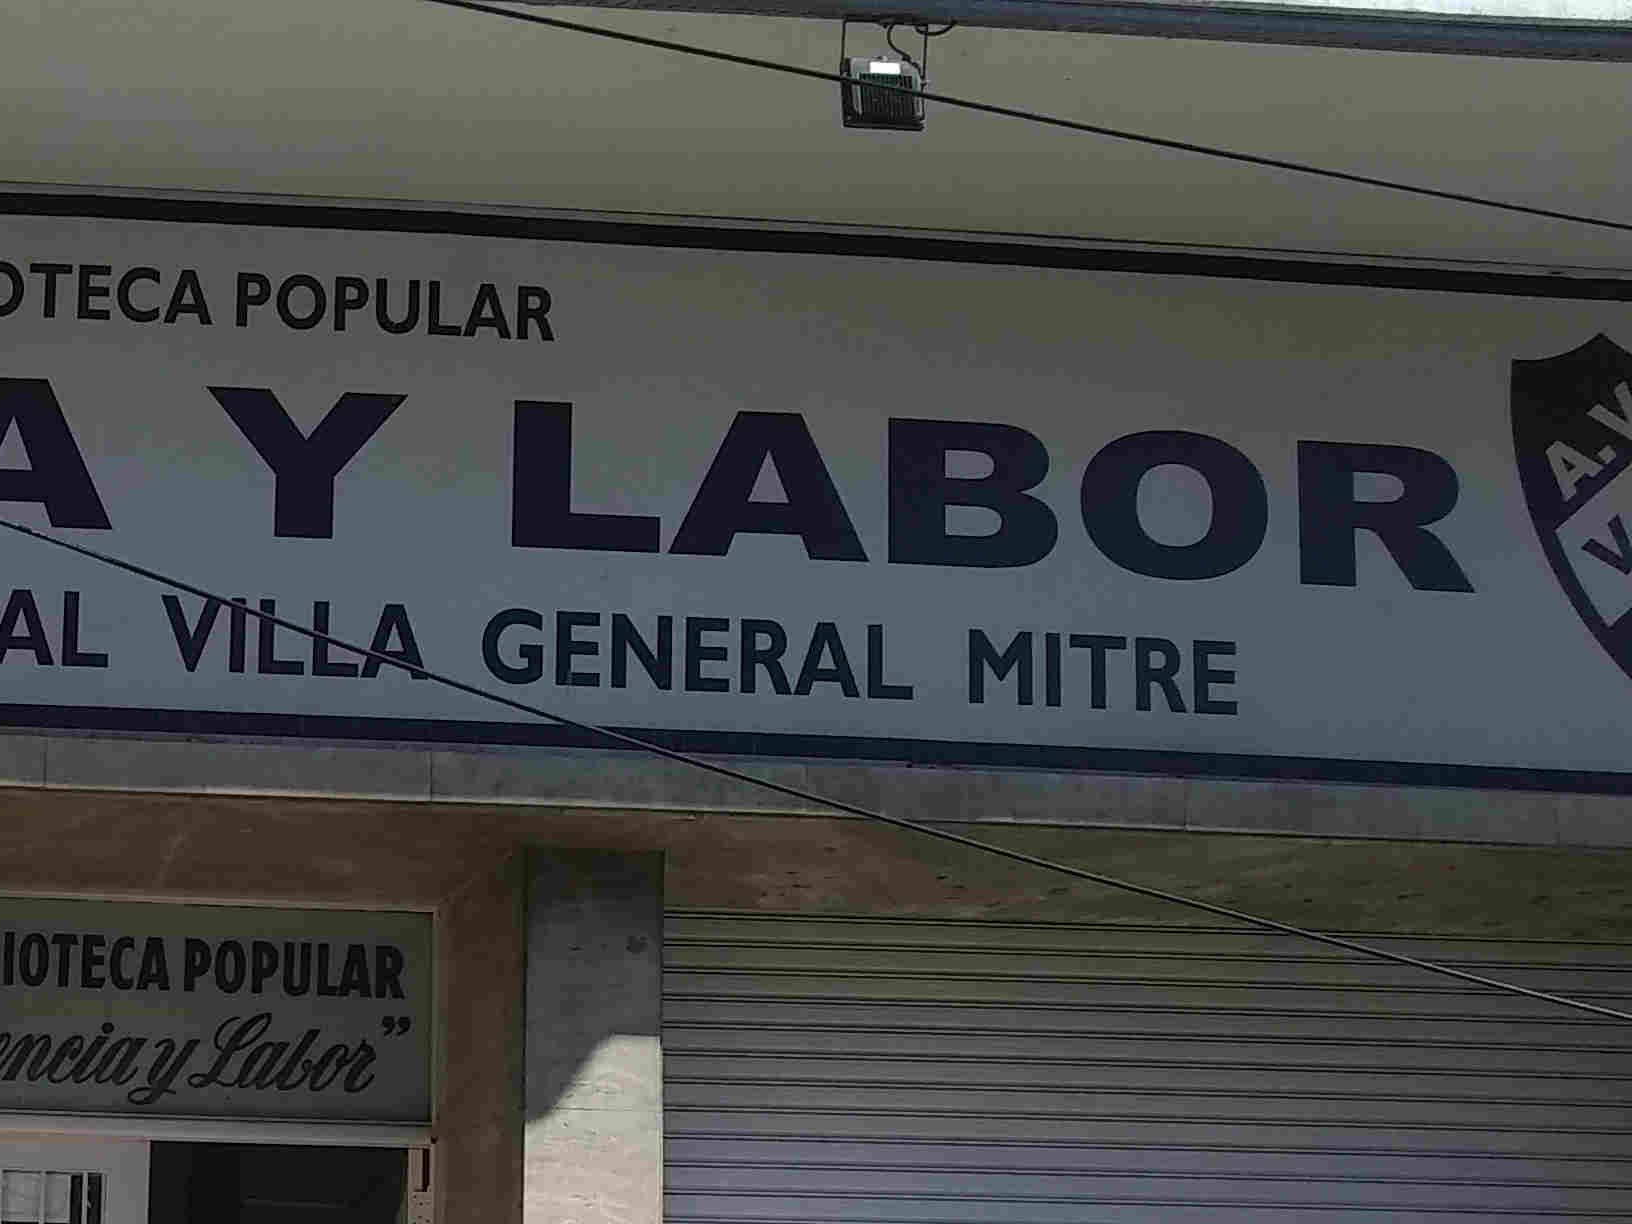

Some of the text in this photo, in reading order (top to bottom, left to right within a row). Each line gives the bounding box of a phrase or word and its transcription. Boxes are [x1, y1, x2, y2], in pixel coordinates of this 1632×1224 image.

[235, 271, 555, 342] POPULAR
[206, 385, 408, 540] Y
[511, 399, 1475, 593] LABOR
[162, 594, 426, 680] VILLA
[481, 608, 914, 701] GENERAL
[968, 628, 1238, 716] MITRE
[183, 936, 406, 1000] POPULAR
[128, 1037, 200, 1105] y
